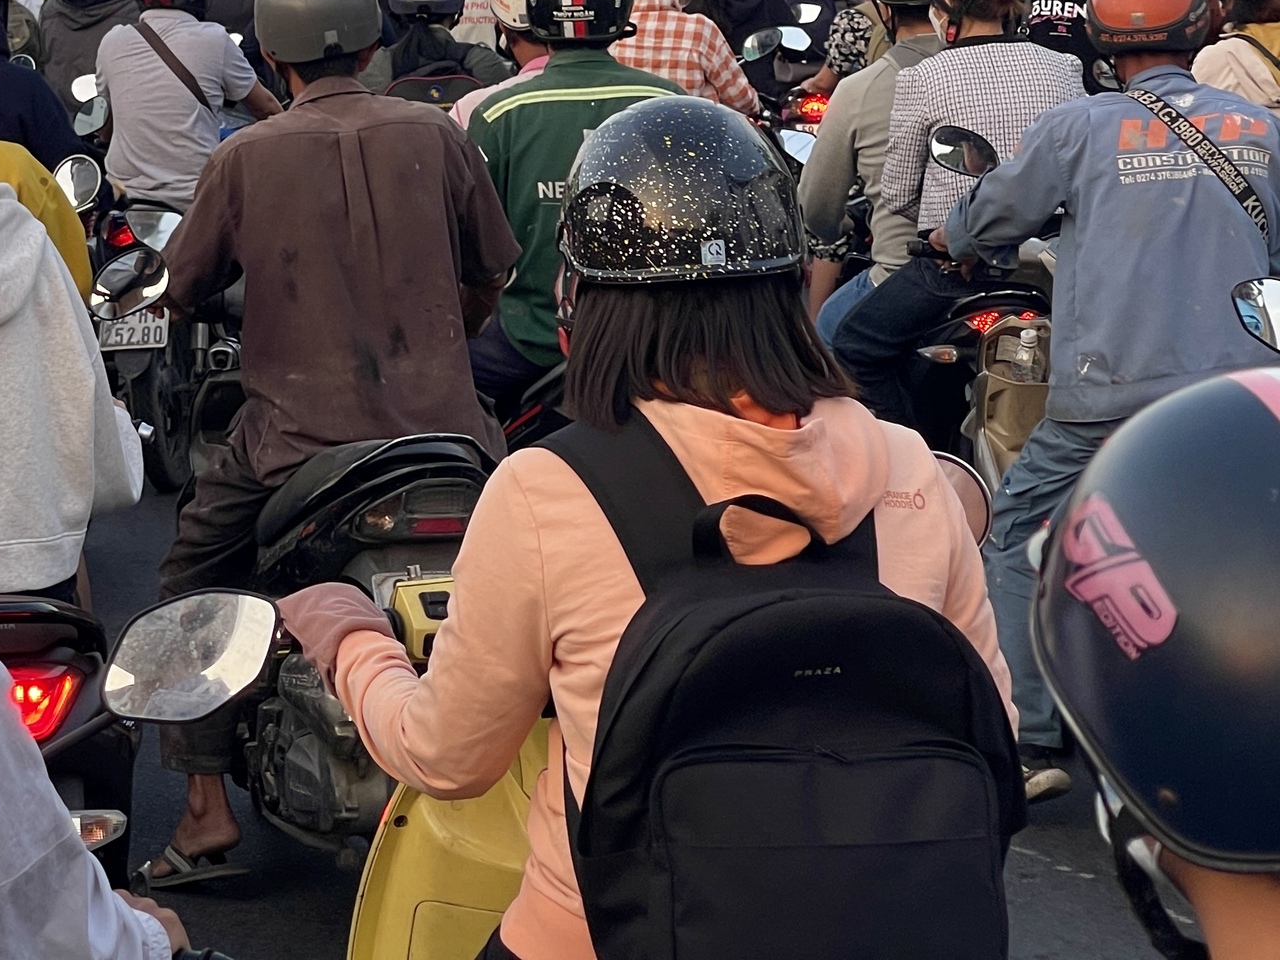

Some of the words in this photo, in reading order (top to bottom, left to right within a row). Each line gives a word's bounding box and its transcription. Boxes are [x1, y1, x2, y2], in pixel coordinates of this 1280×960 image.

[1117, 149, 1270, 170] CONSTRTION
[537, 181, 566, 199] NE
[794, 666, 841, 677] PRAZA
